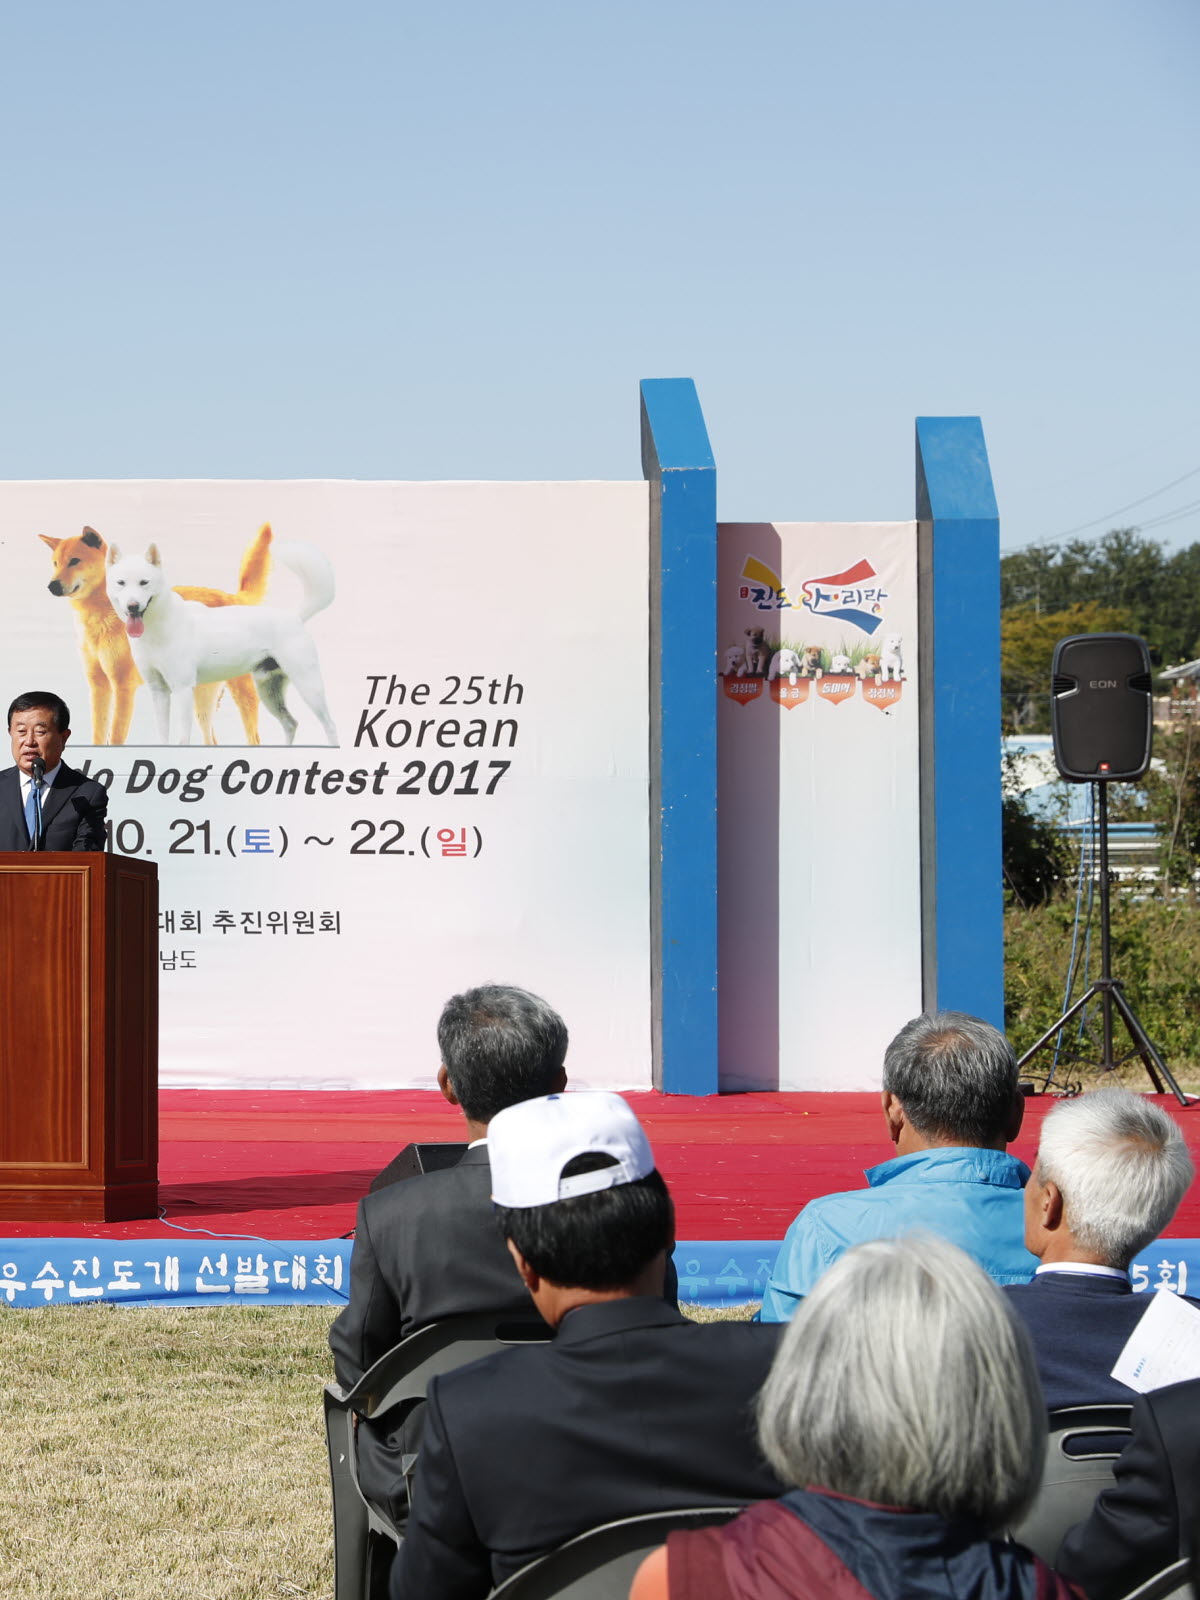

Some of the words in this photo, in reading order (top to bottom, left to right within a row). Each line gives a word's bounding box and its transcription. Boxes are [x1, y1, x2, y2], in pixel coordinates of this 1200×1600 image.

[365, 675, 431, 705] The
[438, 674, 524, 705] 25th
[1090, 680, 1117, 689] EON
[353, 709, 518, 748] Korean
[125, 759, 213, 803] Dog
[220, 759, 387, 795] Contest
[396, 759, 512, 796] 2017
[212, 910, 341, 935] 추진위원회
[195, 1253, 343, 1294] 선발대회
